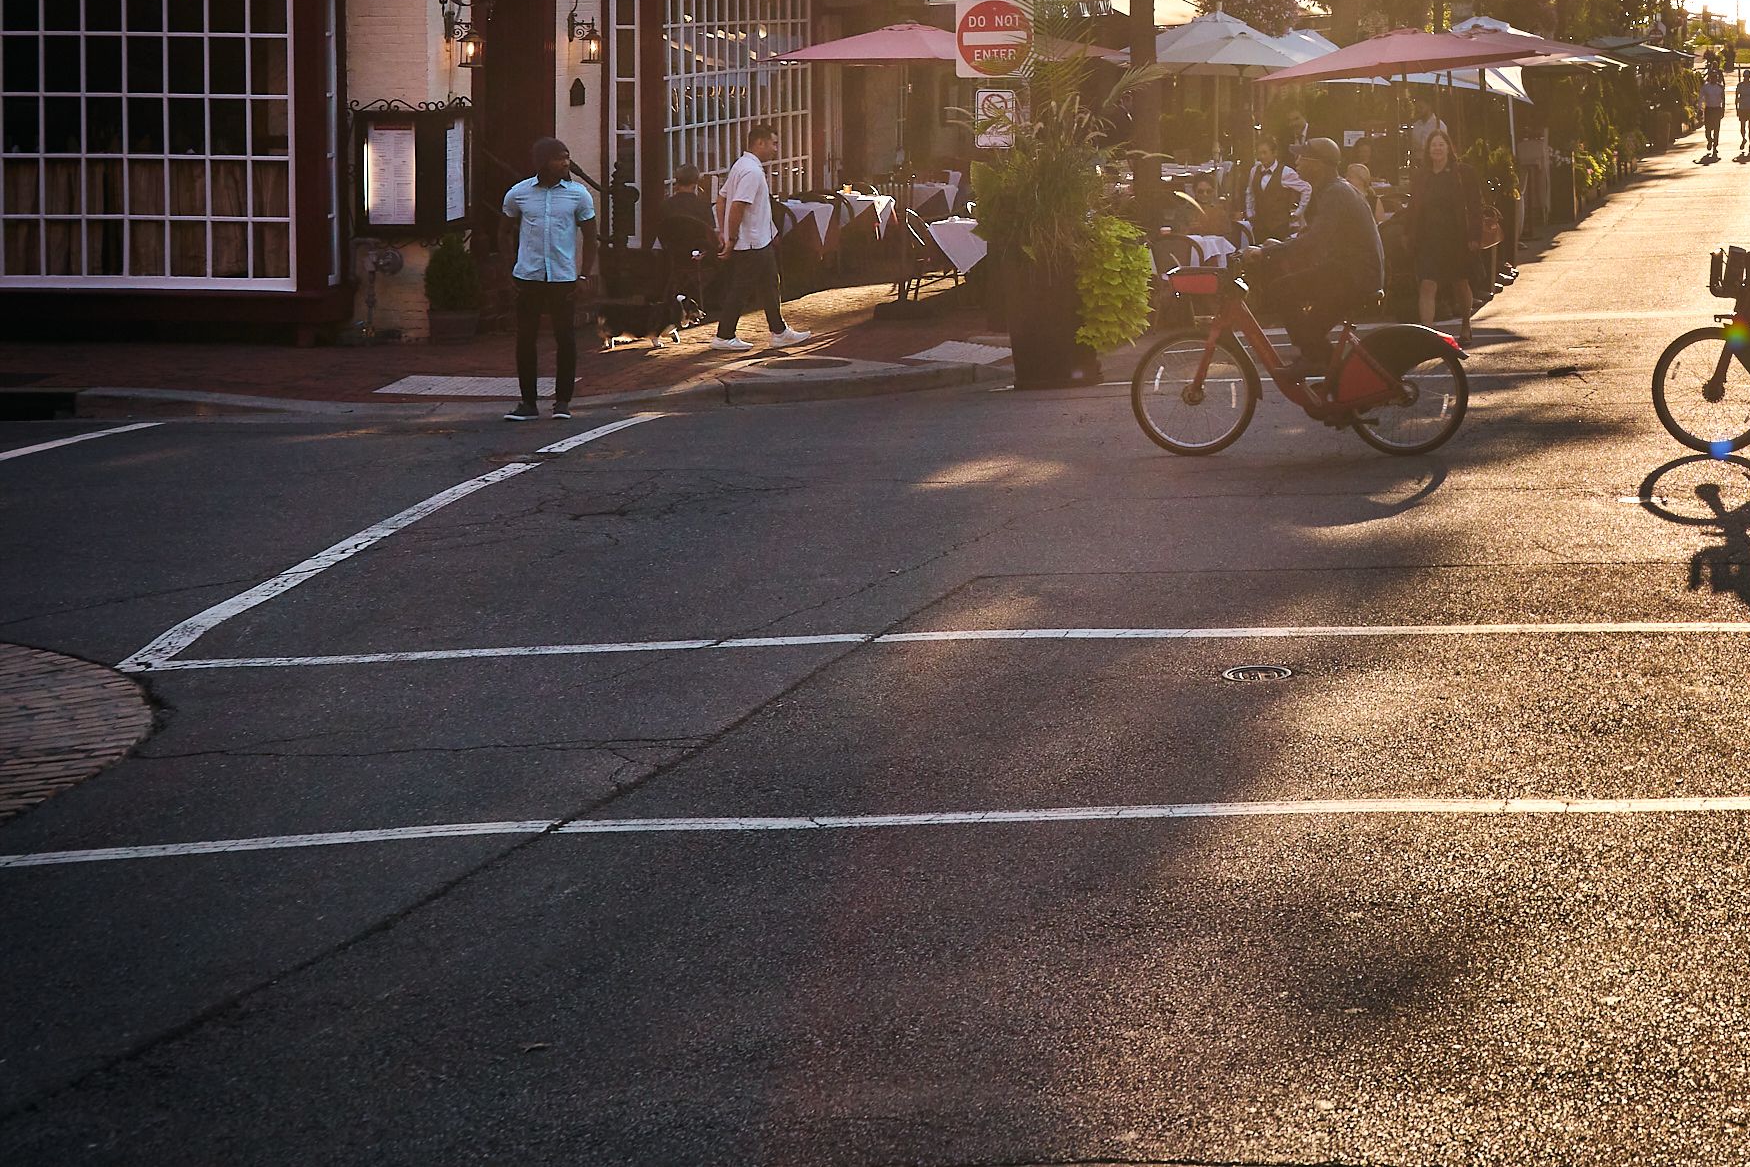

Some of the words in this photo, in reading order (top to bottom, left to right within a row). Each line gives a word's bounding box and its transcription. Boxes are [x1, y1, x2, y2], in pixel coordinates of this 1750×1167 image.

[968, 15, 986, 28] DO
[994, 14, 1020, 27] NOT
[974, 48, 1016, 62] ENTER
